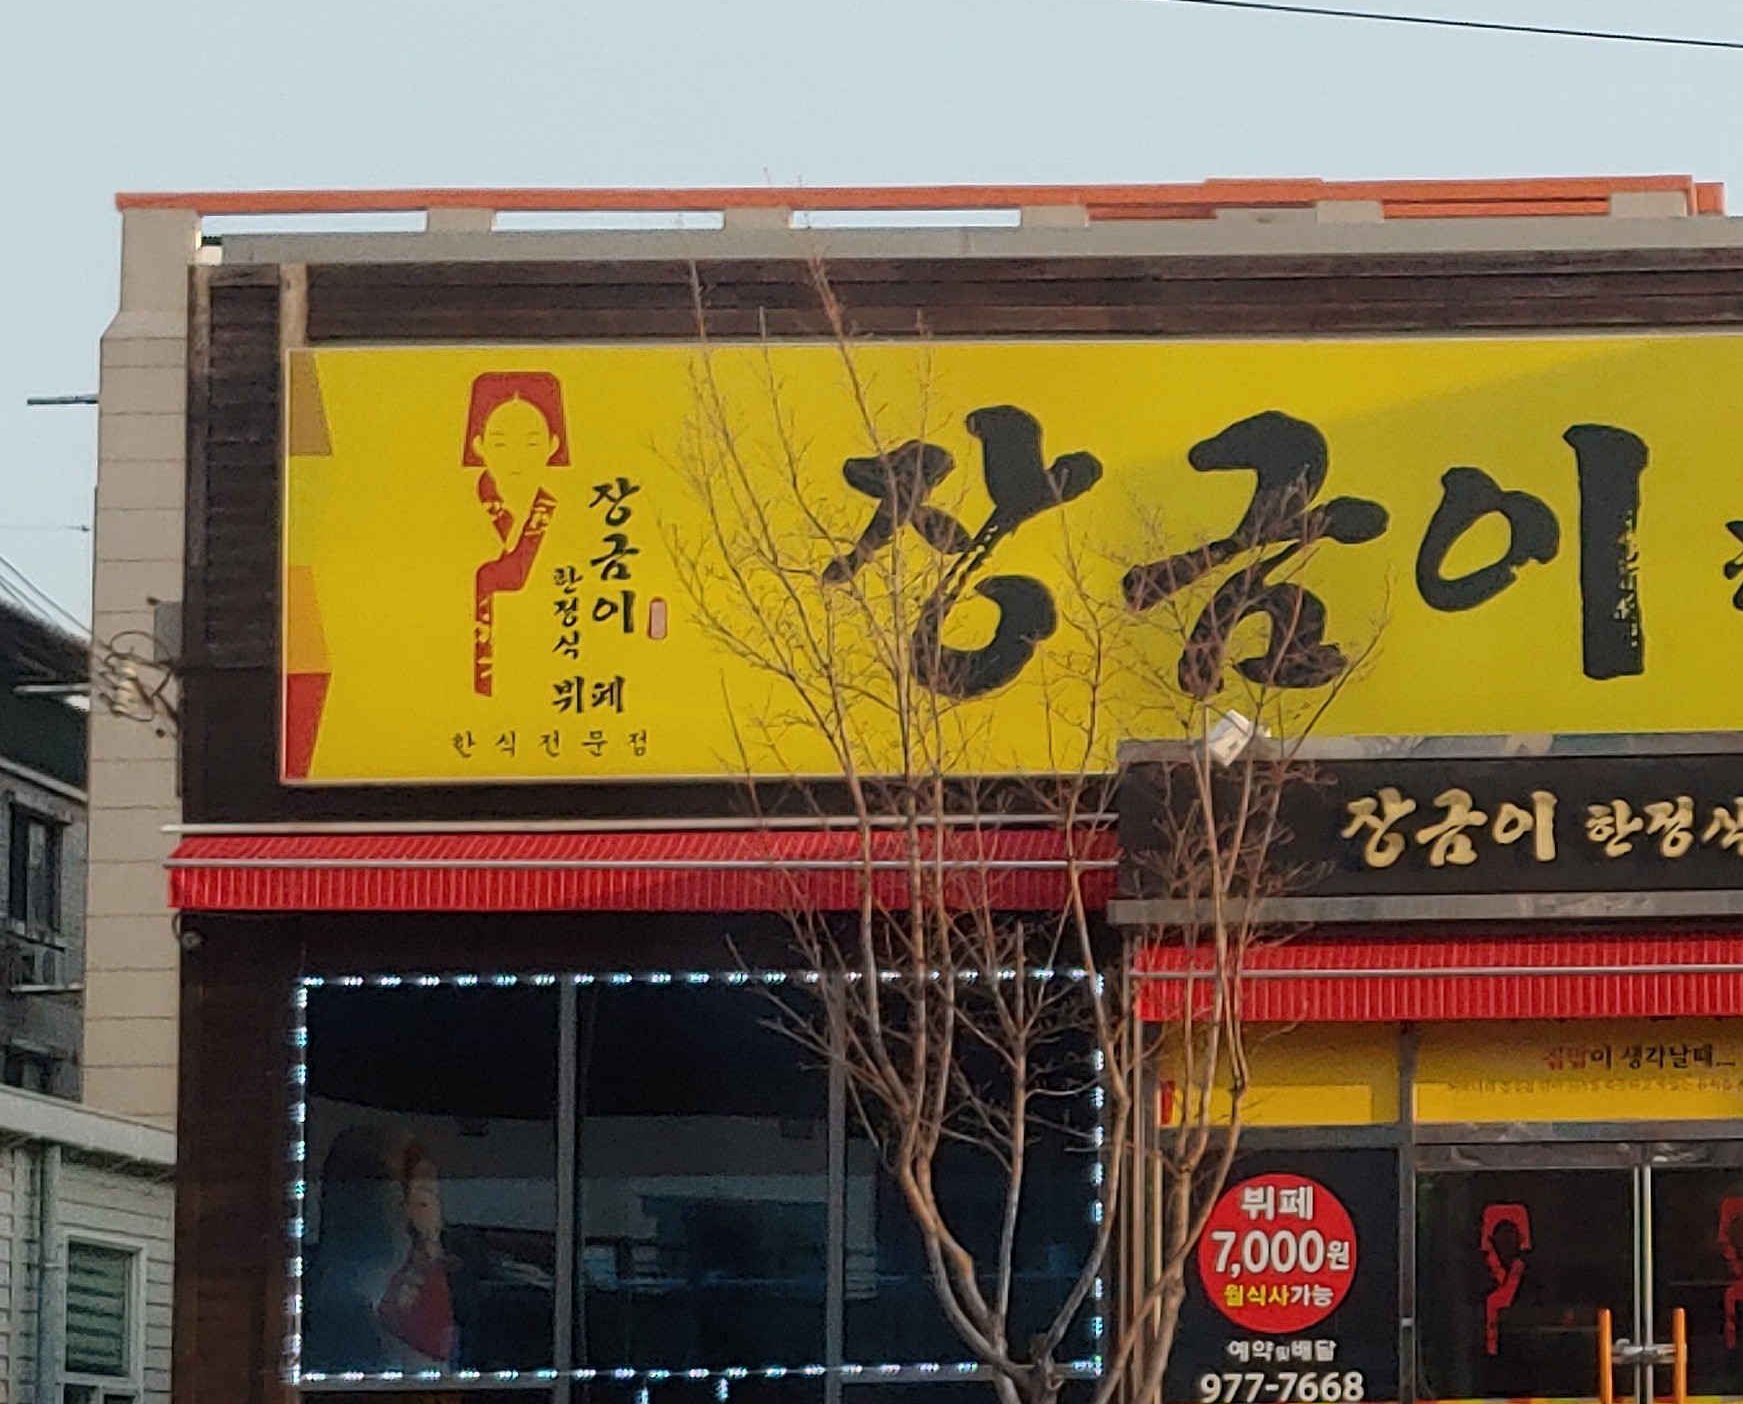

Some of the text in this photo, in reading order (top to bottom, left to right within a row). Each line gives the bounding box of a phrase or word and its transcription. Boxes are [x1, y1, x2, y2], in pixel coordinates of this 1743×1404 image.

[588, 477, 641, 633] 장금이
[822, 404, 1649, 700] 장금이
[552, 565, 584, 660] 한정식
[451, 729, 648, 759] 한식전문점
[1341, 788, 1558, 867] 장금이
[1240, 1185, 1314, 1220] 뷔페
[1199, 1370, 1366, 1404] 977-7668
